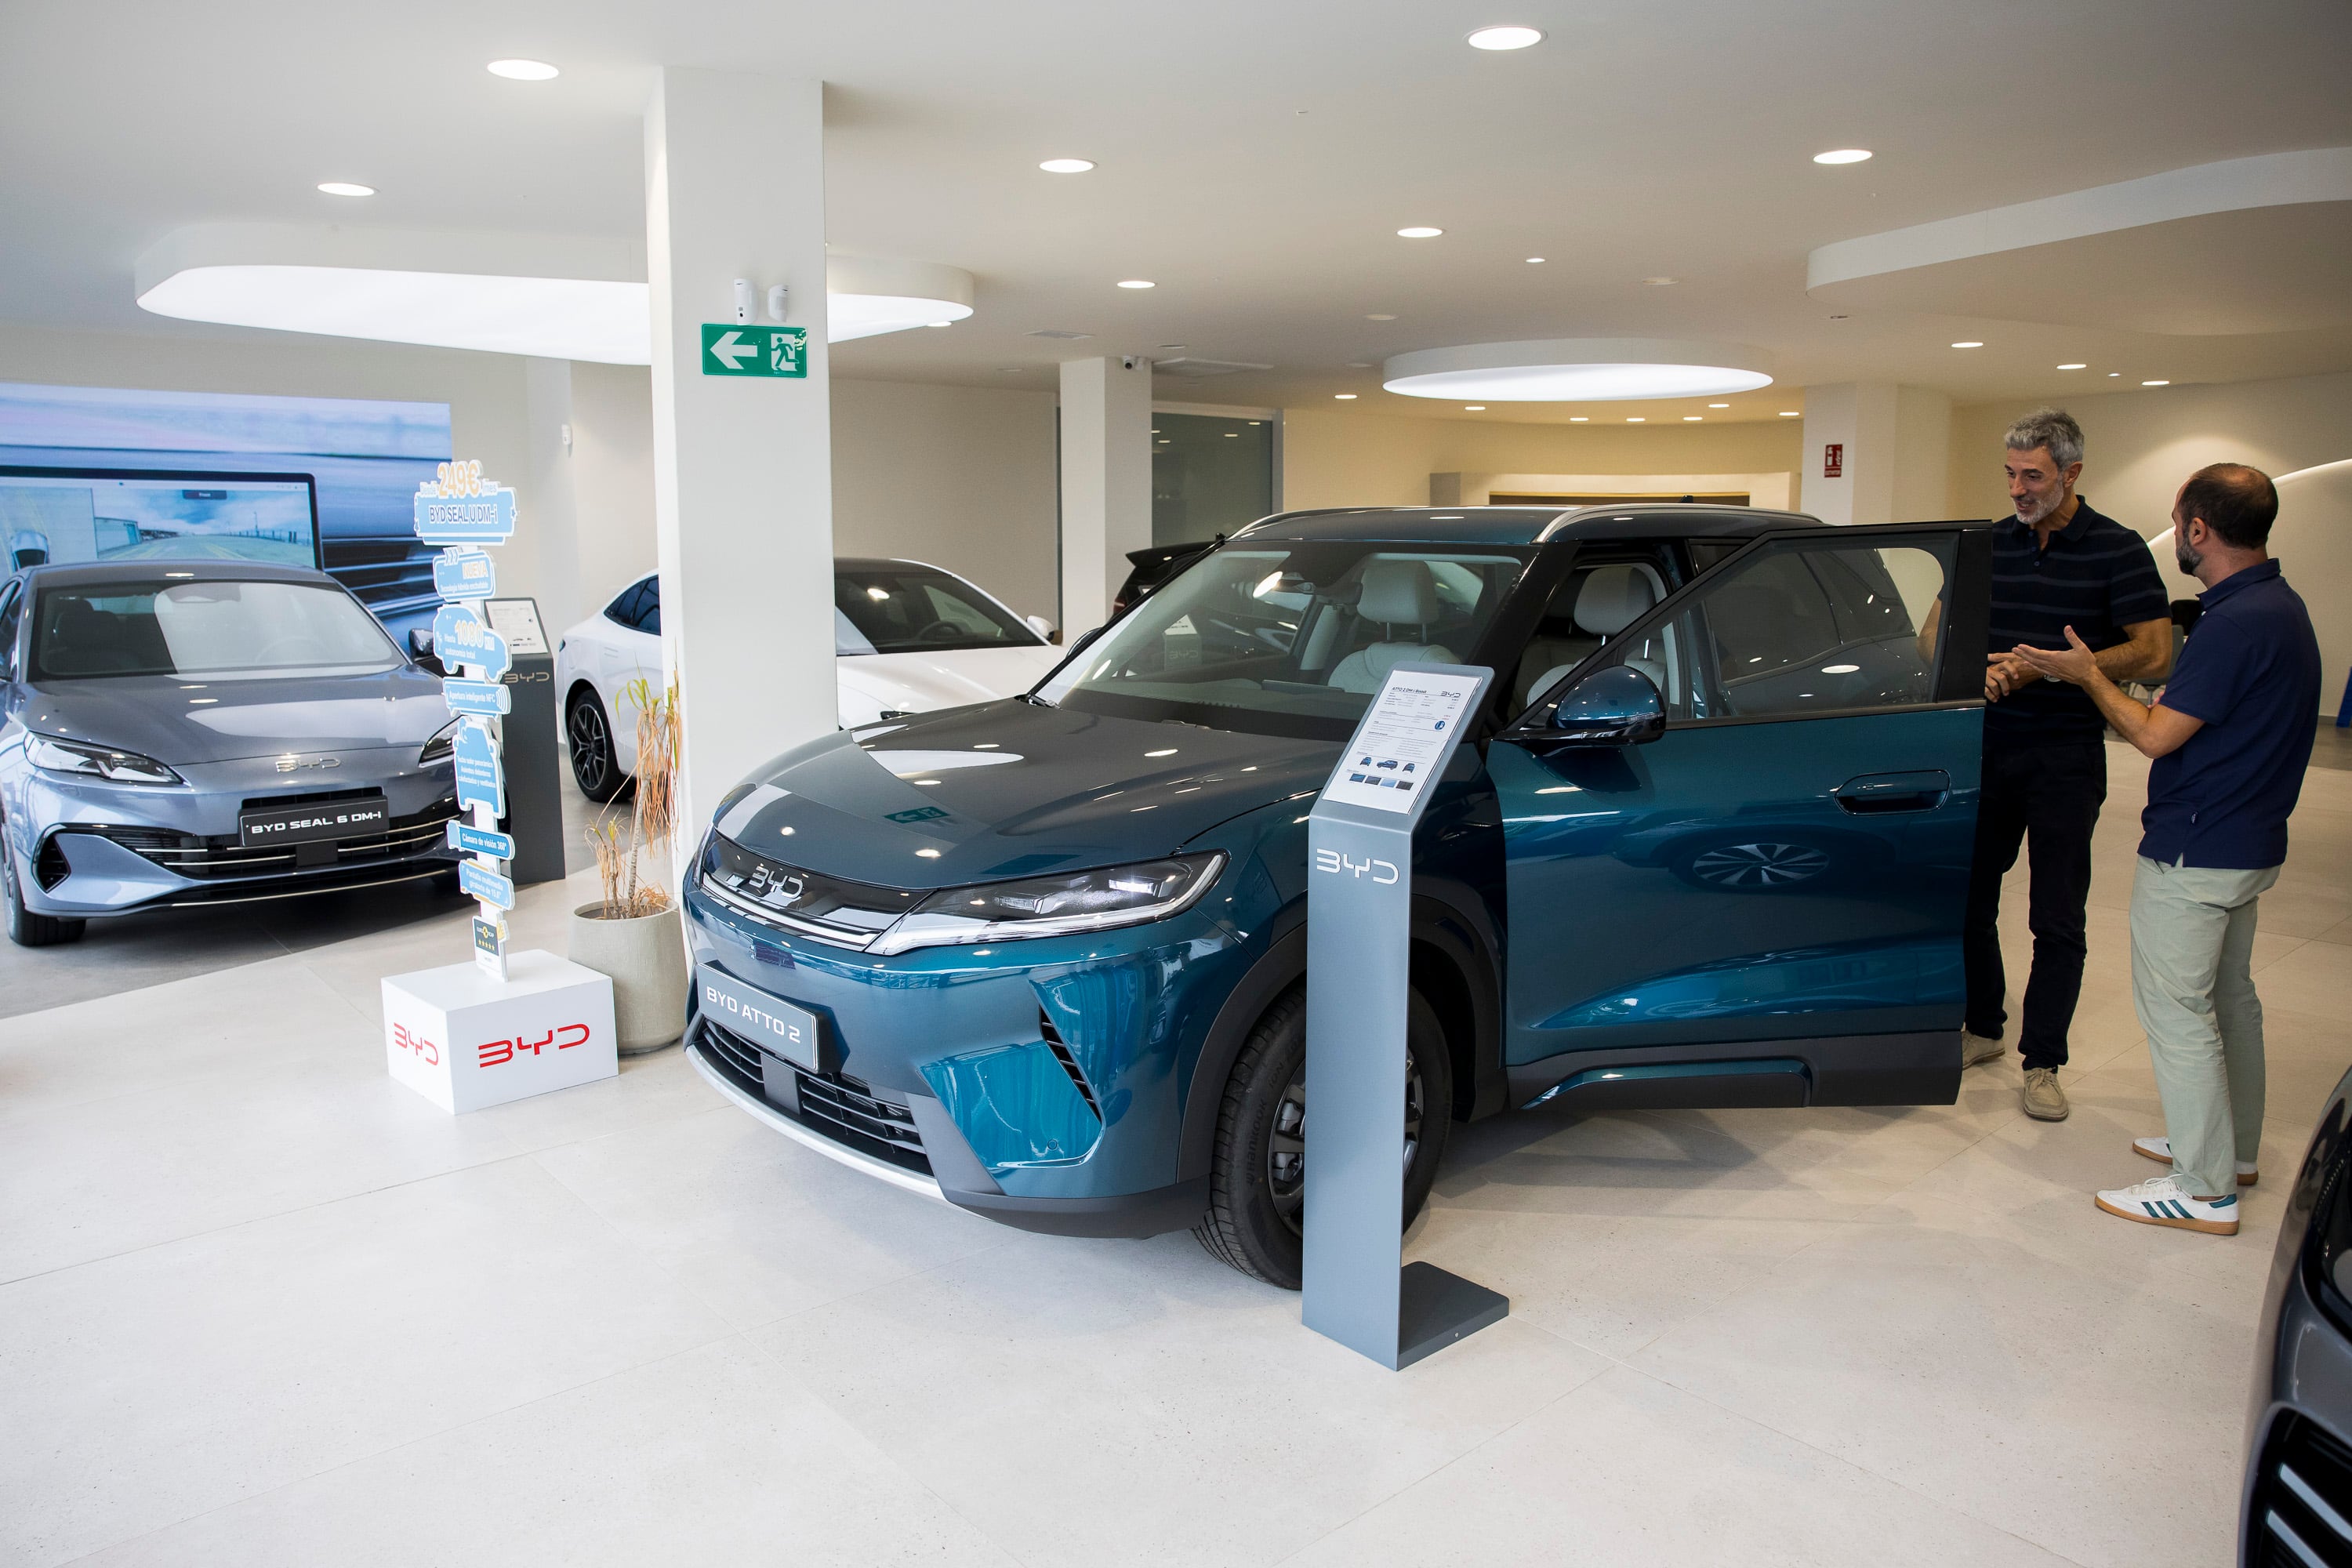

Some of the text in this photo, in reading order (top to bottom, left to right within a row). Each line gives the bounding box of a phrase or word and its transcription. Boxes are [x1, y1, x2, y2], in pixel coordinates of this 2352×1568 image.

[438, 463, 480, 495] 249€
[430, 504, 498, 522] BYD SEAL U DM-i
[463, 561, 488, 579] NUEVA
[455, 619, 484, 648] 1080
[504, 671, 550, 684] BYD
[449, 690, 466, 701] Apertura
[486, 693, 495, 703] NFC
[276, 757, 342, 772] BYD
[251, 822, 286, 834] BYD
[289, 817, 333, 829] SEAL
[336, 815, 348, 824] 6
[462, 833, 478, 845] Cámara
[477, 837, 484, 846] de
[484, 839, 497, 849] visión
[1316, 848, 1399, 885] BYD
[749, 866, 803, 898] BYD
[706, 985, 801, 1044] BYD ATTO 2
[394, 1022, 439, 1066] BYD
[478, 1023, 590, 1069] BYD
